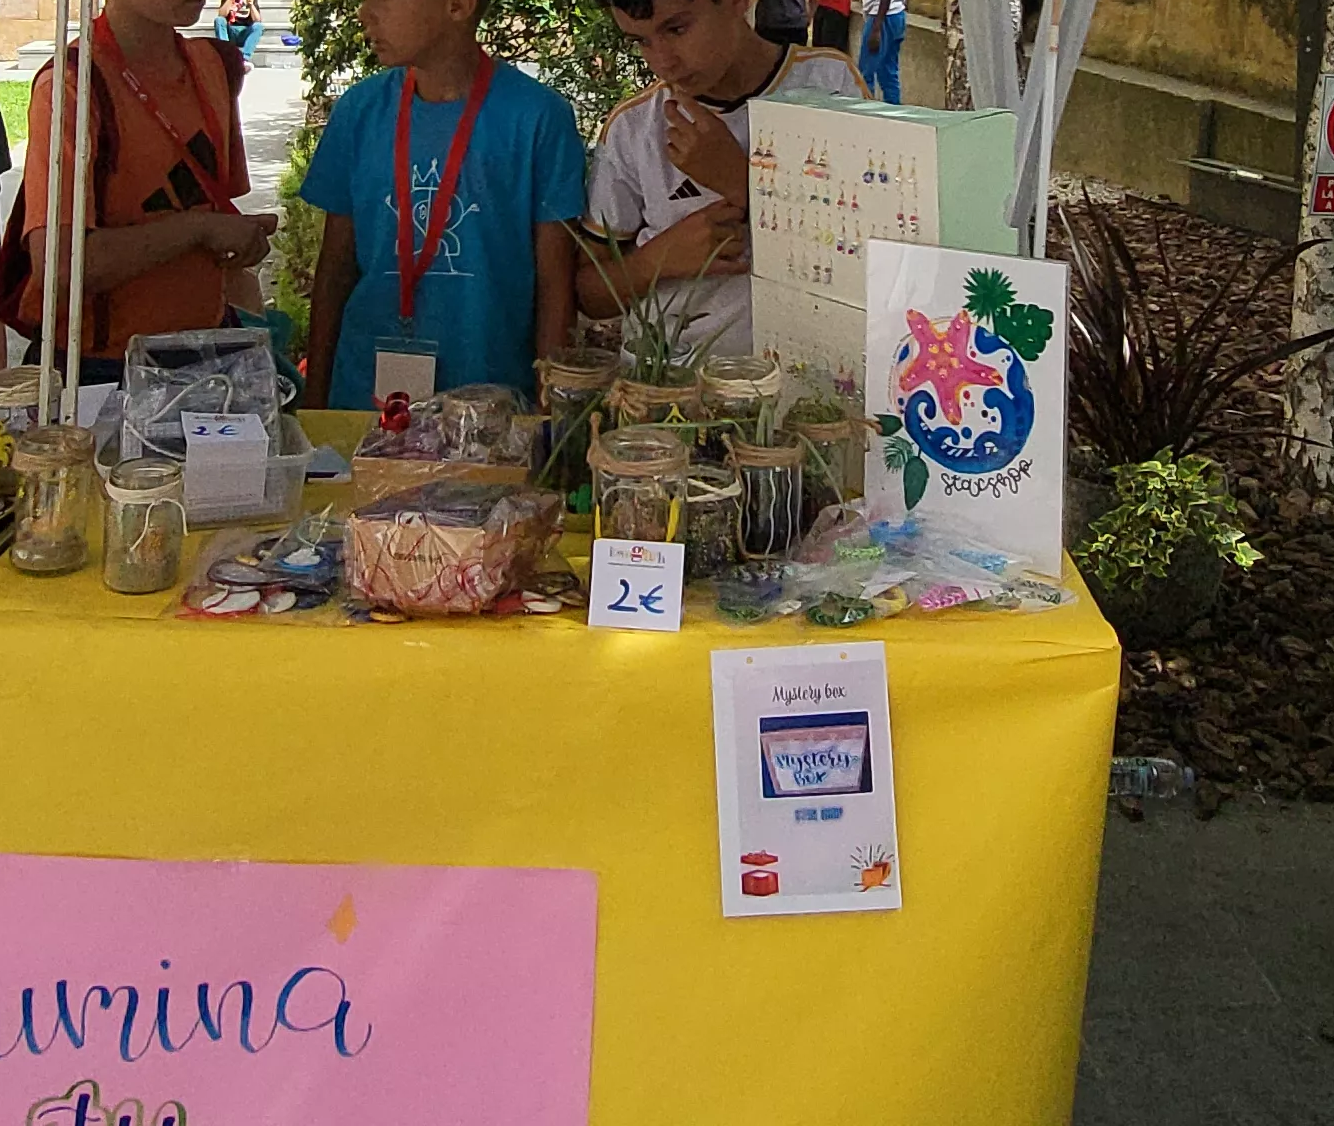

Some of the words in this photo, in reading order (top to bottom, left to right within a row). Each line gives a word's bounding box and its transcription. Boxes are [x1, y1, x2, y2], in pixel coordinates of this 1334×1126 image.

[1321, 189, 1334, 200] LA
[1325, 200, 1333, 211] A
[772, 684, 822, 706] Mystery
[824, 682, 848, 700] box
